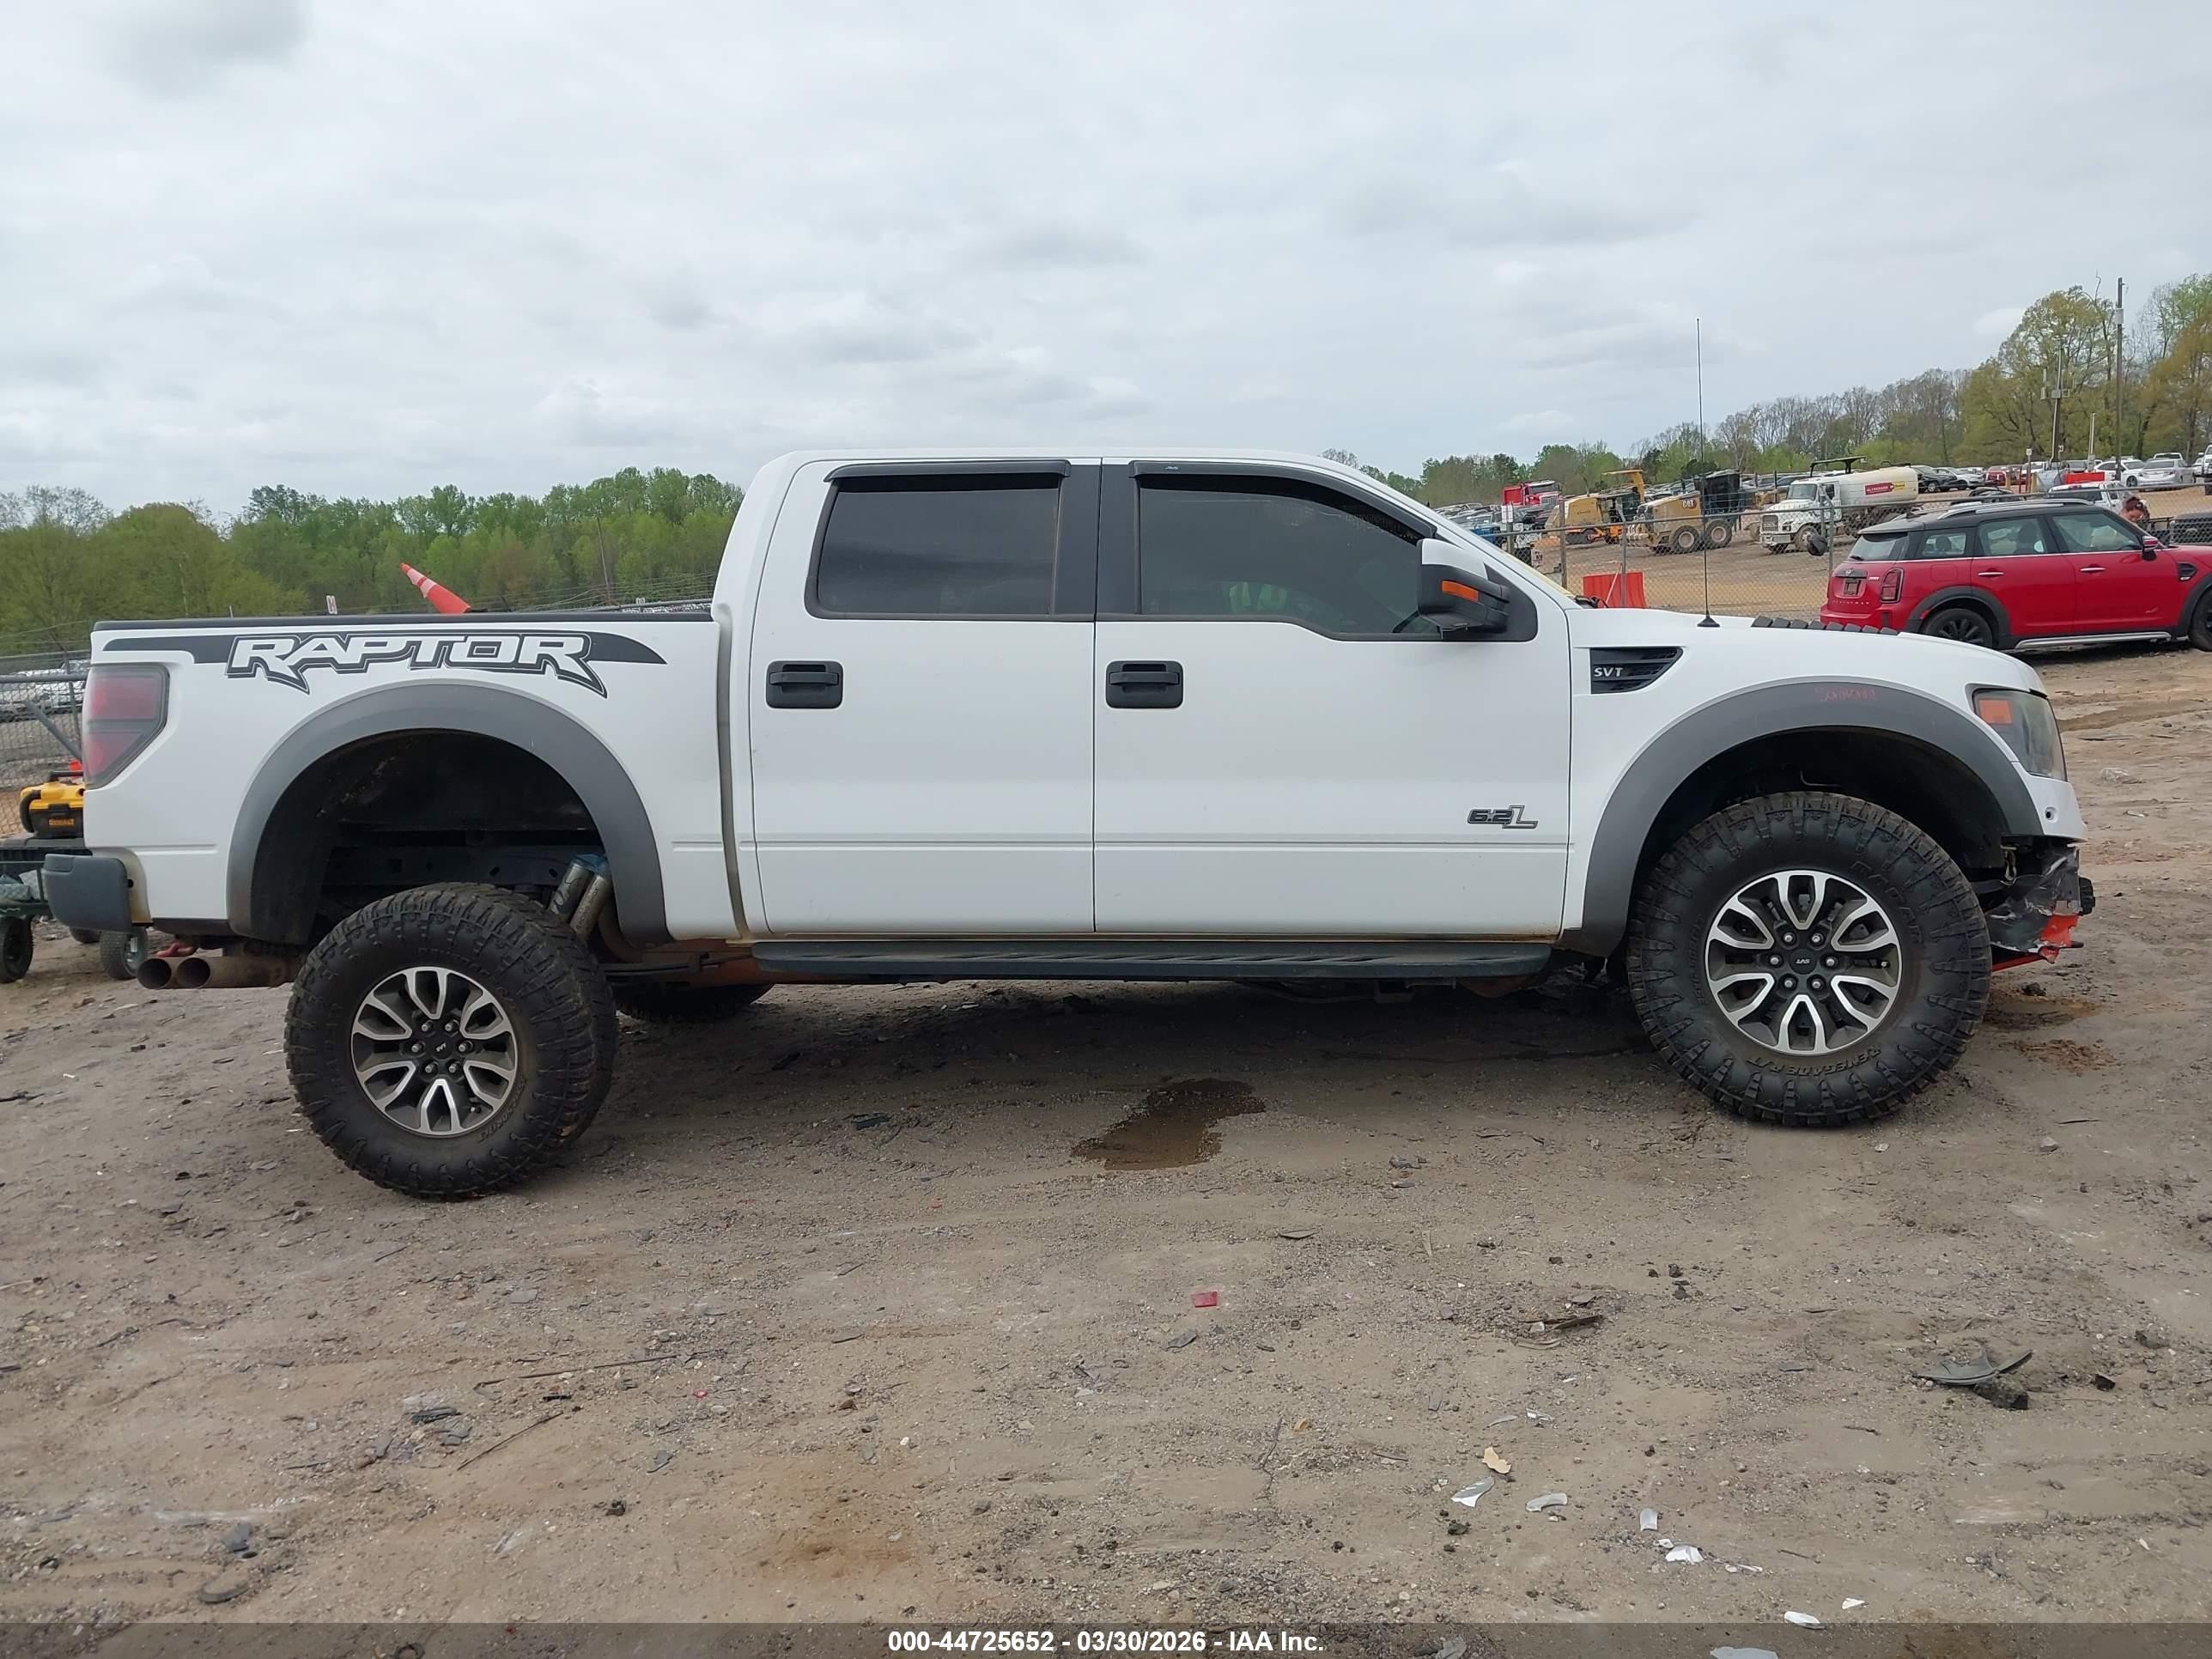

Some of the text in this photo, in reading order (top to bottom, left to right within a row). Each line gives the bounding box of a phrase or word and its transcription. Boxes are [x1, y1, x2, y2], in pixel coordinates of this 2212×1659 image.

[1684, 500, 1694, 508] CAT
[224, 633, 608, 699] RAPTOR
[1593, 666, 1624, 677] SVT
[1467, 805, 1539, 829] 6.2L
[1786, 1045, 1882, 1077] RENEGADE
